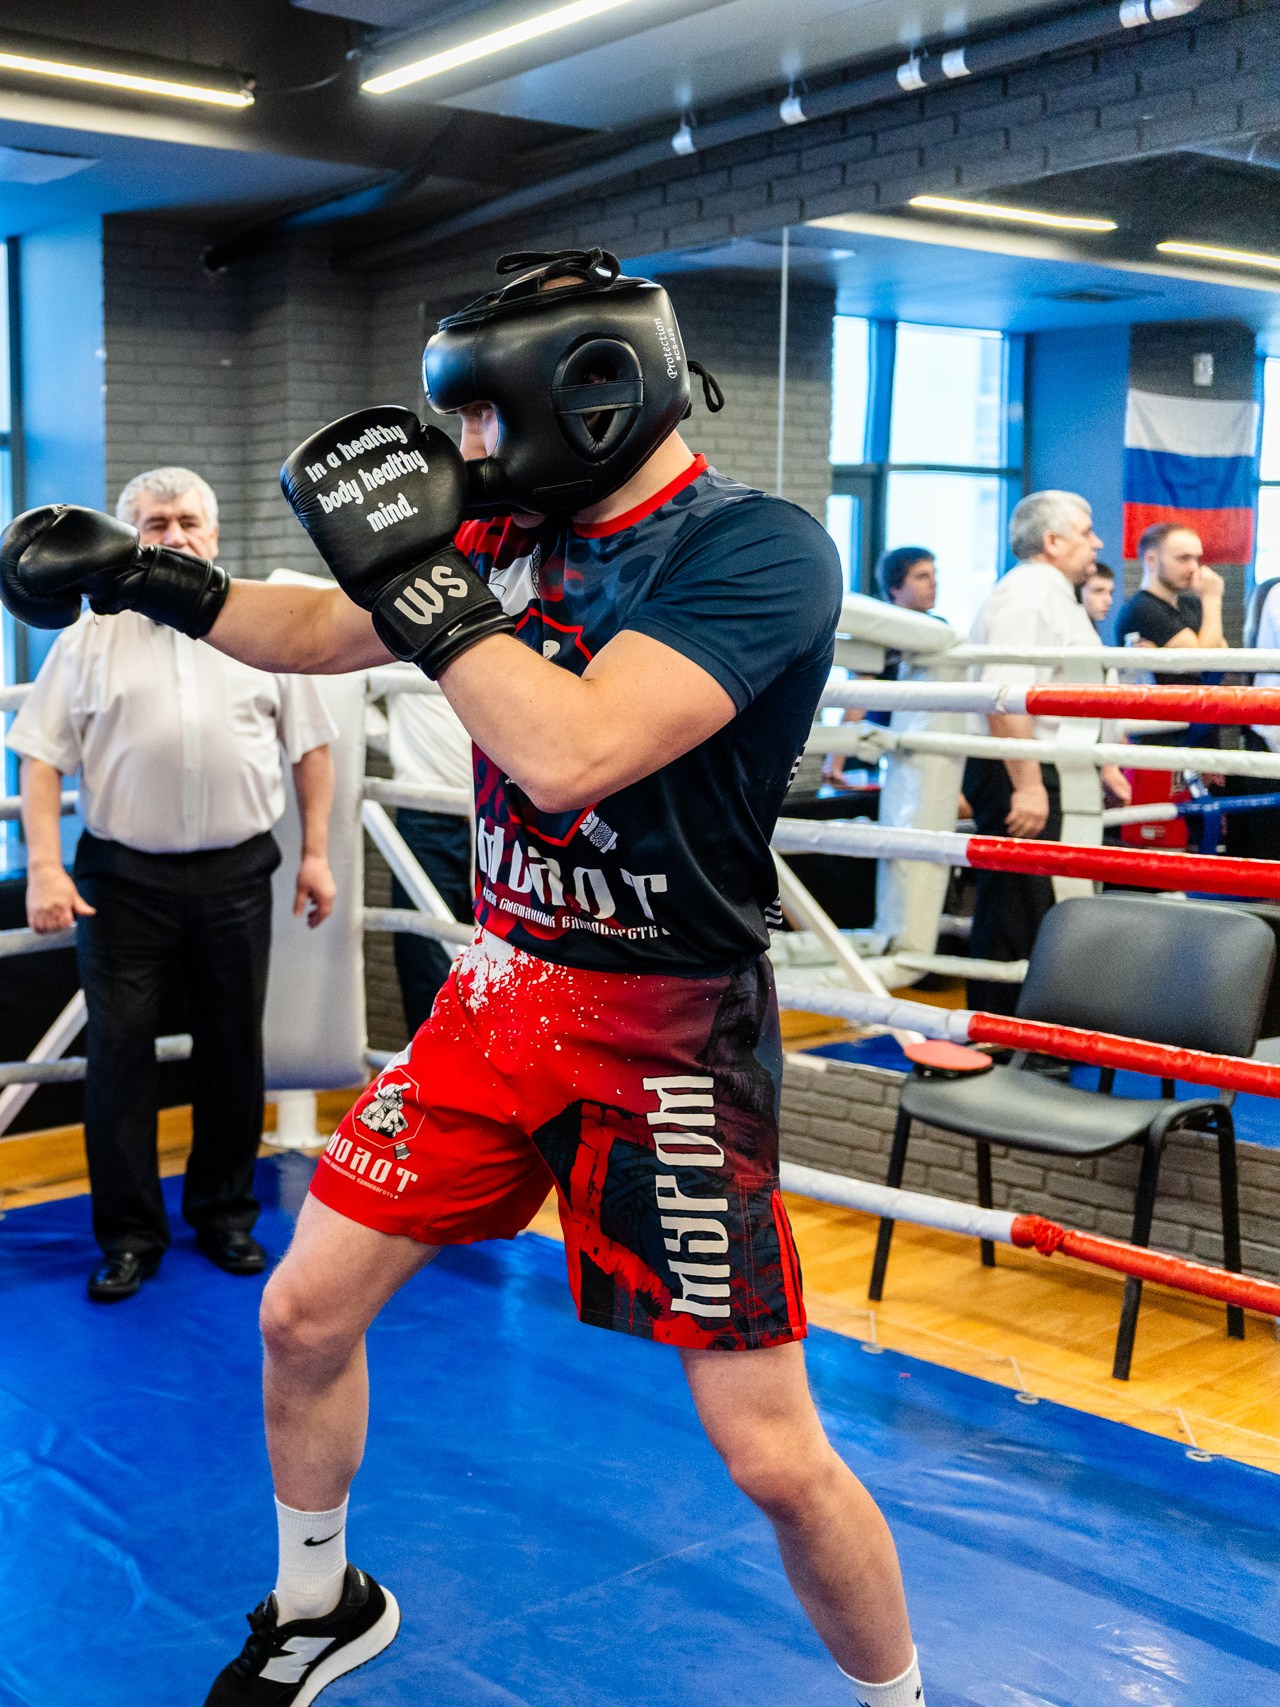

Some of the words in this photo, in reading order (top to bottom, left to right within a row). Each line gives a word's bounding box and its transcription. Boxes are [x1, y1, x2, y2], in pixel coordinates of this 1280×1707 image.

[654, 316, 678, 379] Protection
[305, 463, 327, 483] In
[327, 451, 341, 468] a
[337, 424, 409, 462] healthy
[317, 480, 364, 514] body
[358, 449, 429, 493] healthy
[366, 492, 419, 533] mind.
[393, 565, 468, 625] WS
[642, 1075, 731, 1318] МУРОМ
